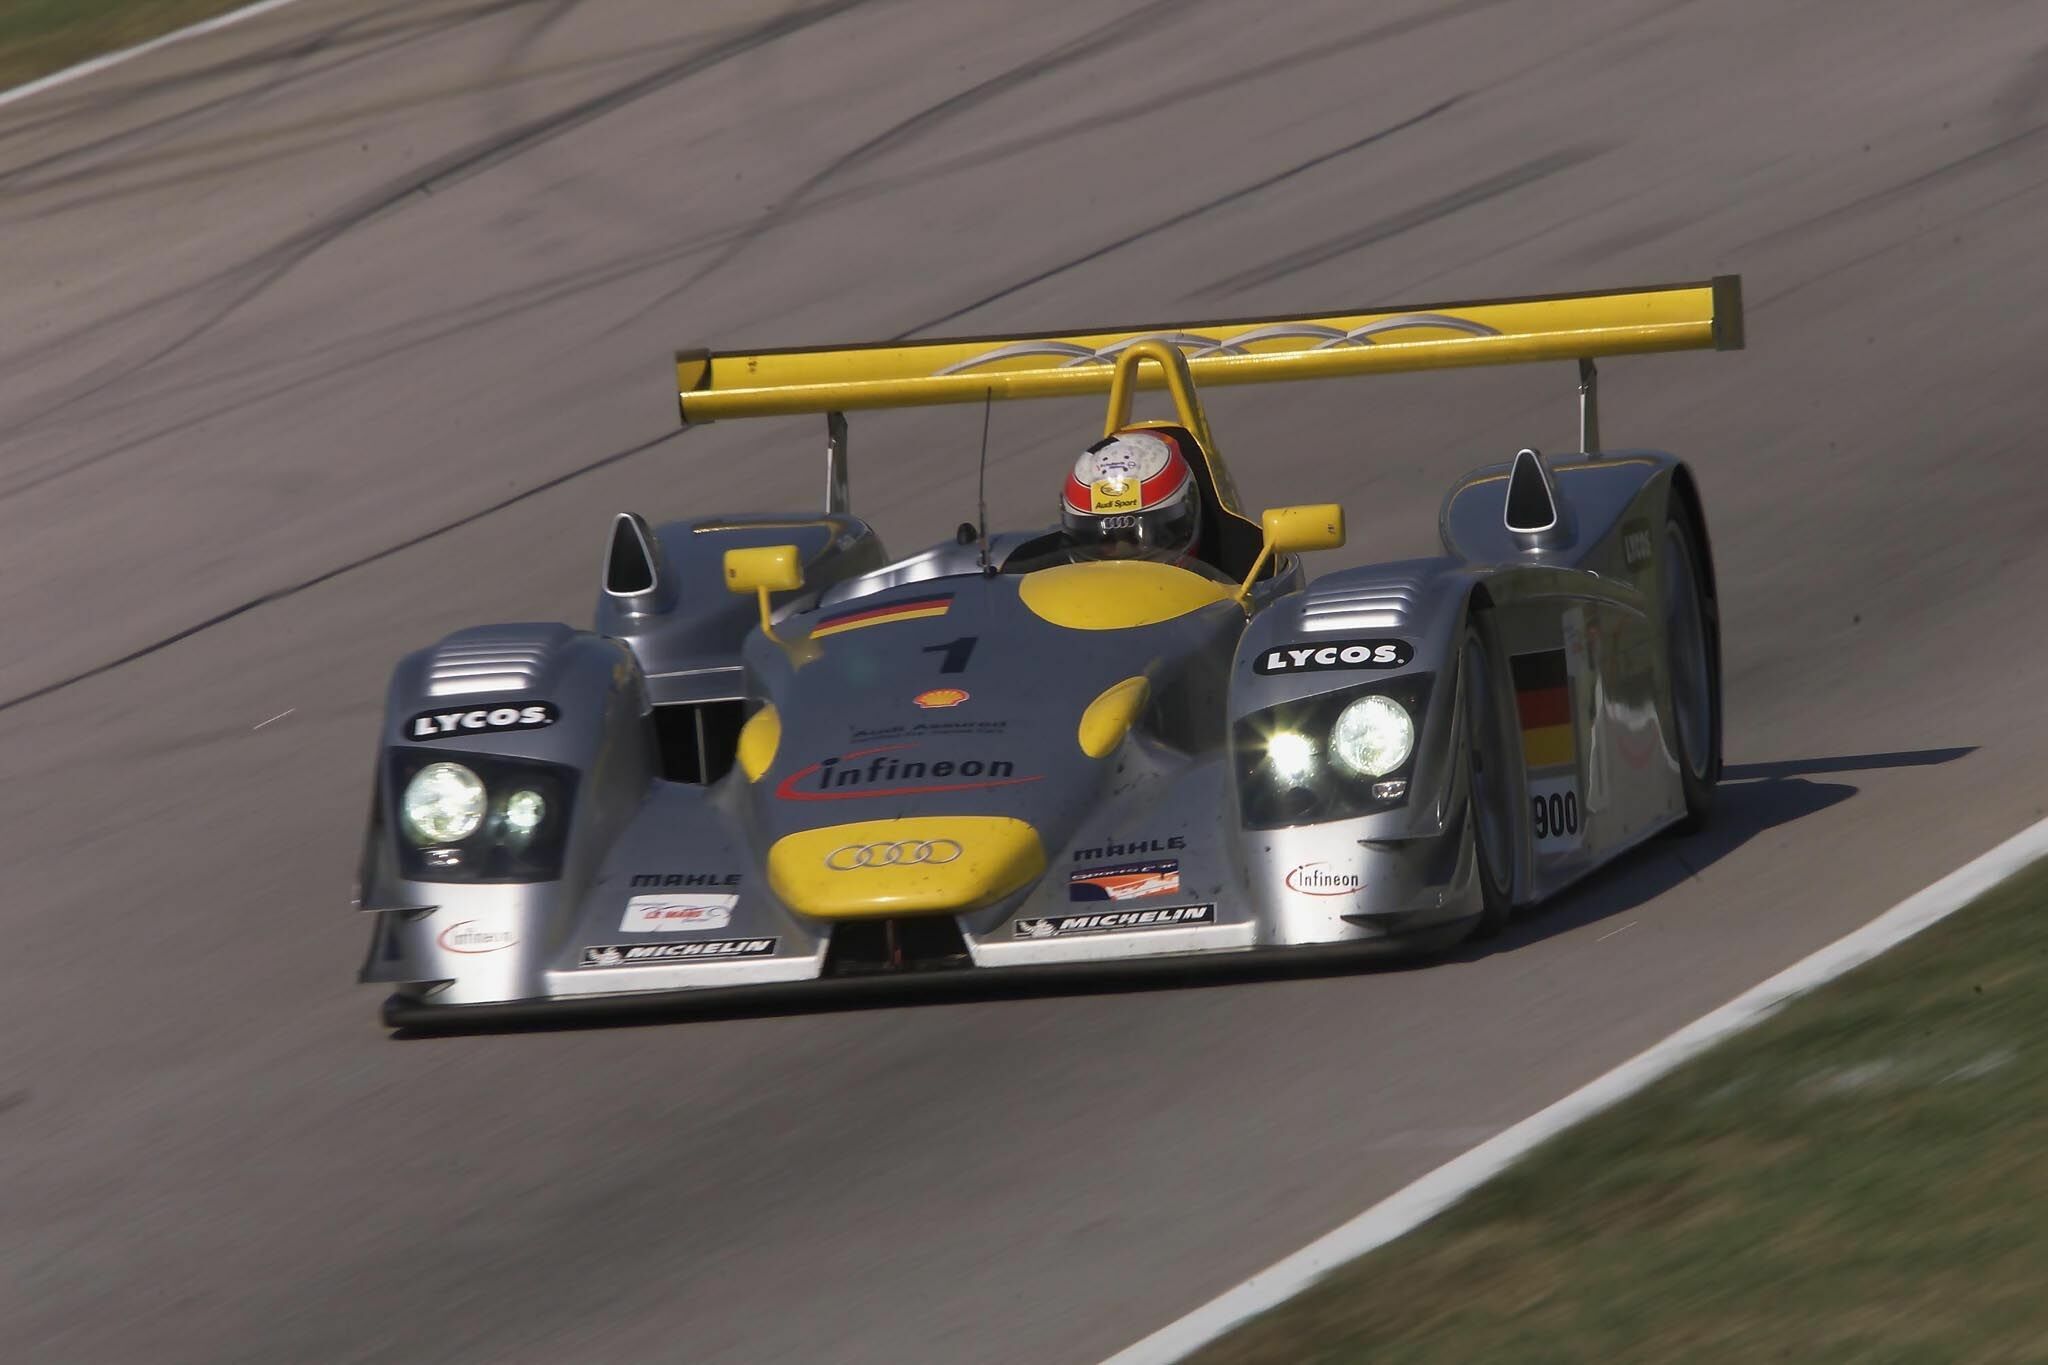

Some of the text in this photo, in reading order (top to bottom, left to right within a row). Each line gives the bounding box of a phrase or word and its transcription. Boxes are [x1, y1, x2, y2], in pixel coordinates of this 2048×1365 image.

[1096, 499, 1138, 509] Audi Sport
[922, 636, 979, 675] 1
[819, 756, 1015, 790] infineon
[1534, 790, 1578, 840] 900
[1073, 836, 1187, 862] MAHLE
[630, 874, 744, 888] MAHLE
[1060, 906, 1208, 930] MICHELIN
[624, 940, 772, 959] MICHELIN
